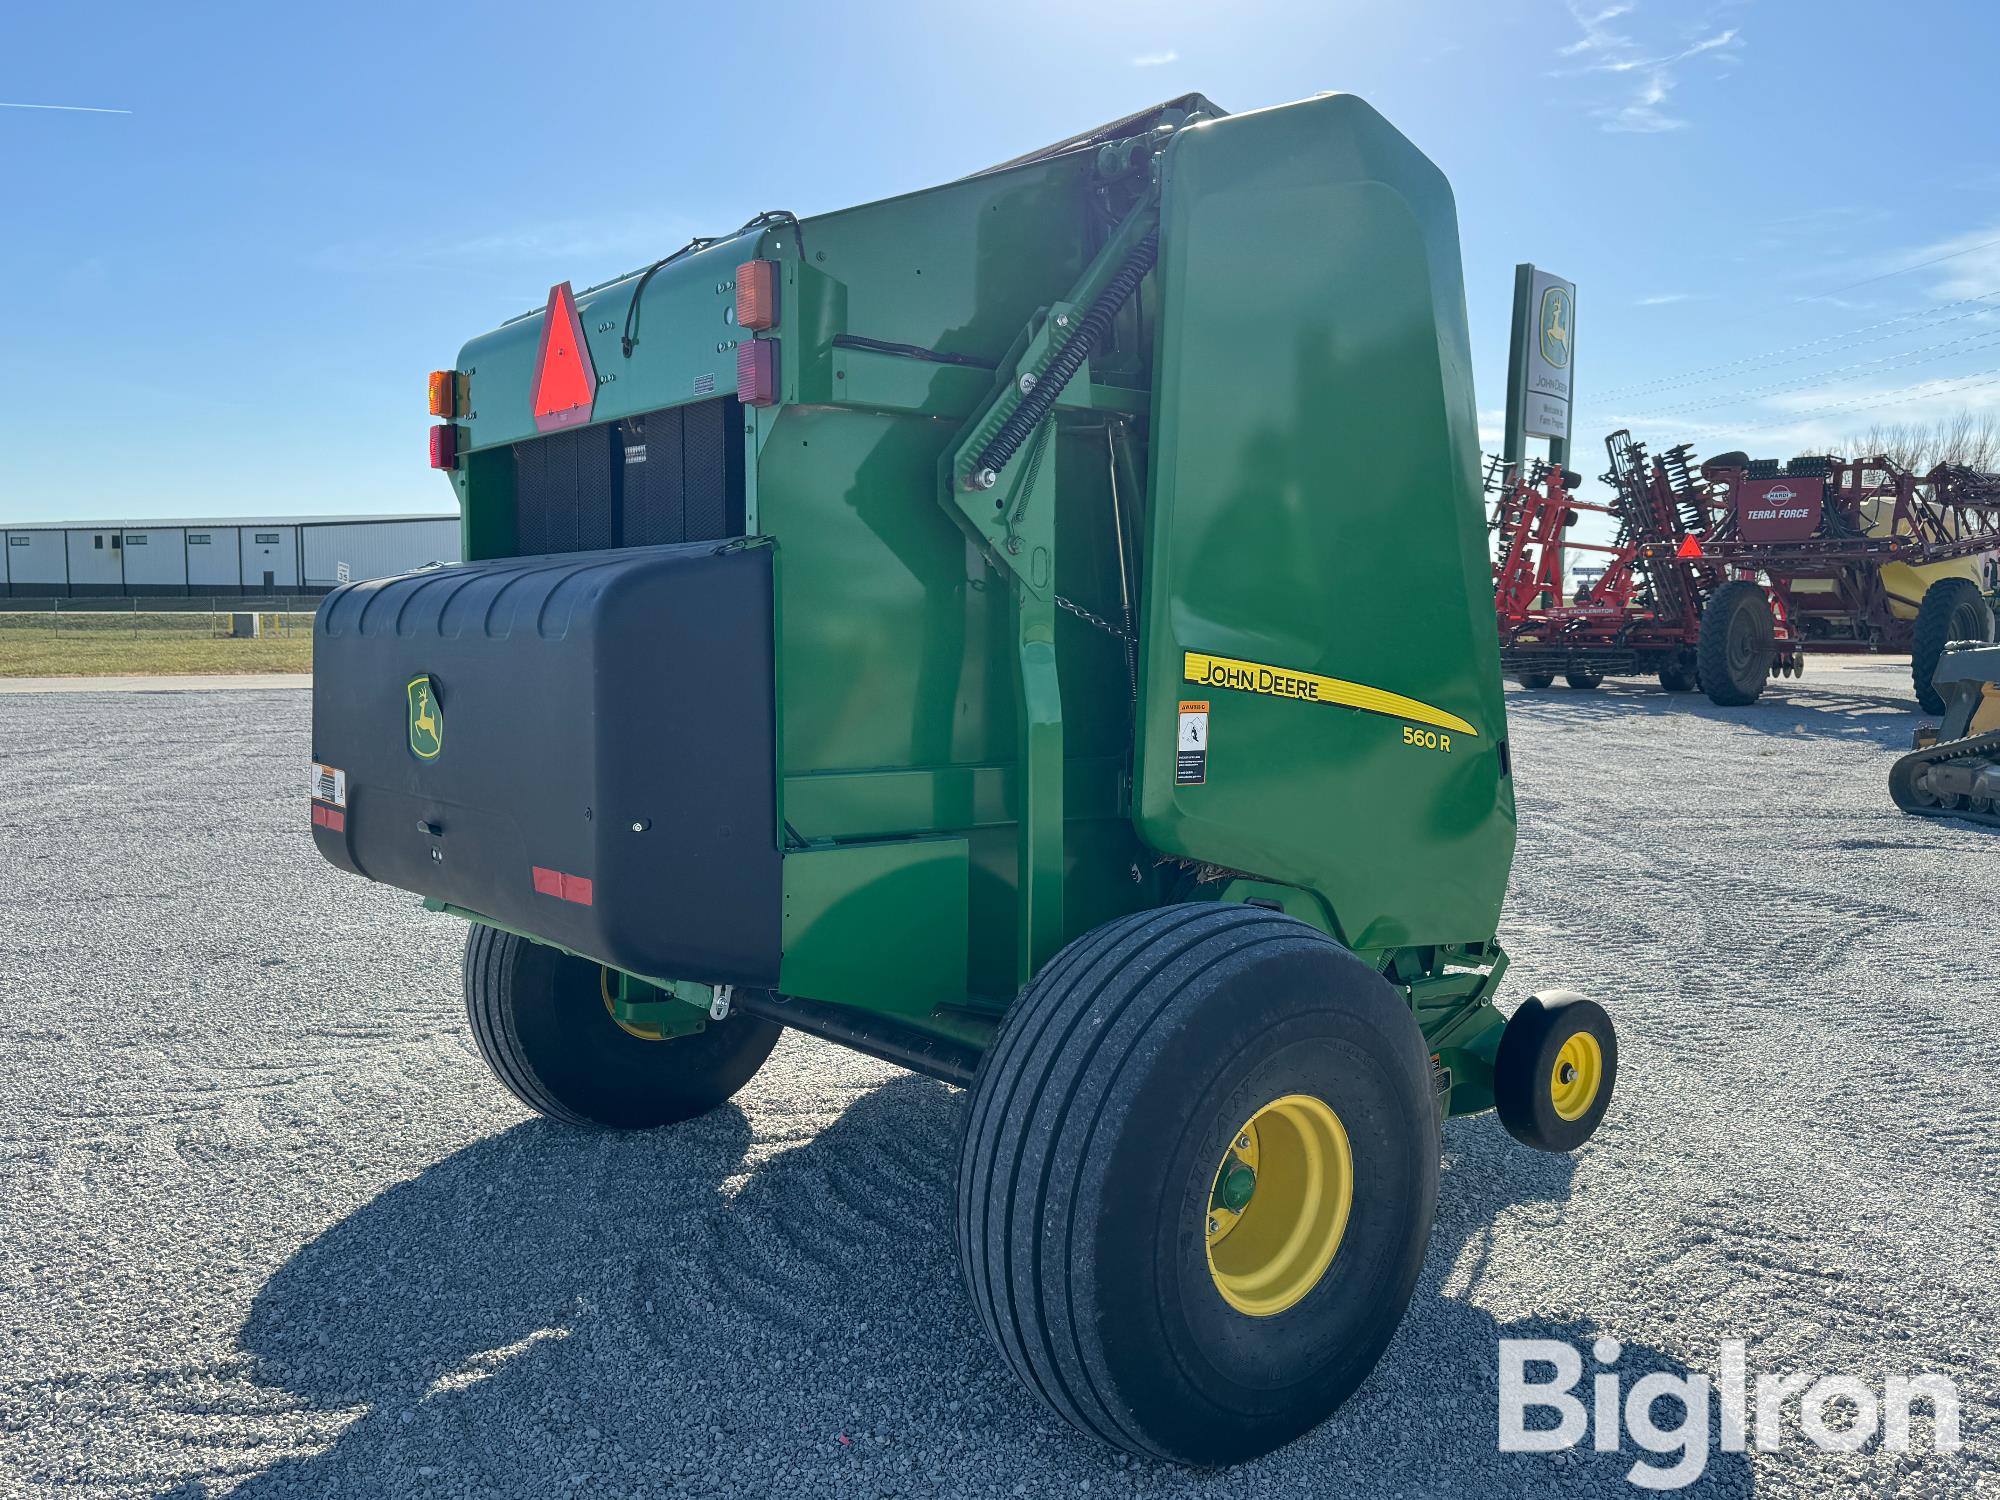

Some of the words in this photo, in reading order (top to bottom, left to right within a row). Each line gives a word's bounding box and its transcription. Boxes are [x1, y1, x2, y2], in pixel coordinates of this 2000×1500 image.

[1536, 374, 1555, 389] JOHN
[1555, 379, 1568, 394] DEER
[1747, 510, 1776, 520] TERRA
[1778, 508, 1809, 519] FORCE
[338, 572, 348, 582] 35
[1200, 661, 1254, 689] JOHN
[1259, 669, 1319, 699] DEERE
